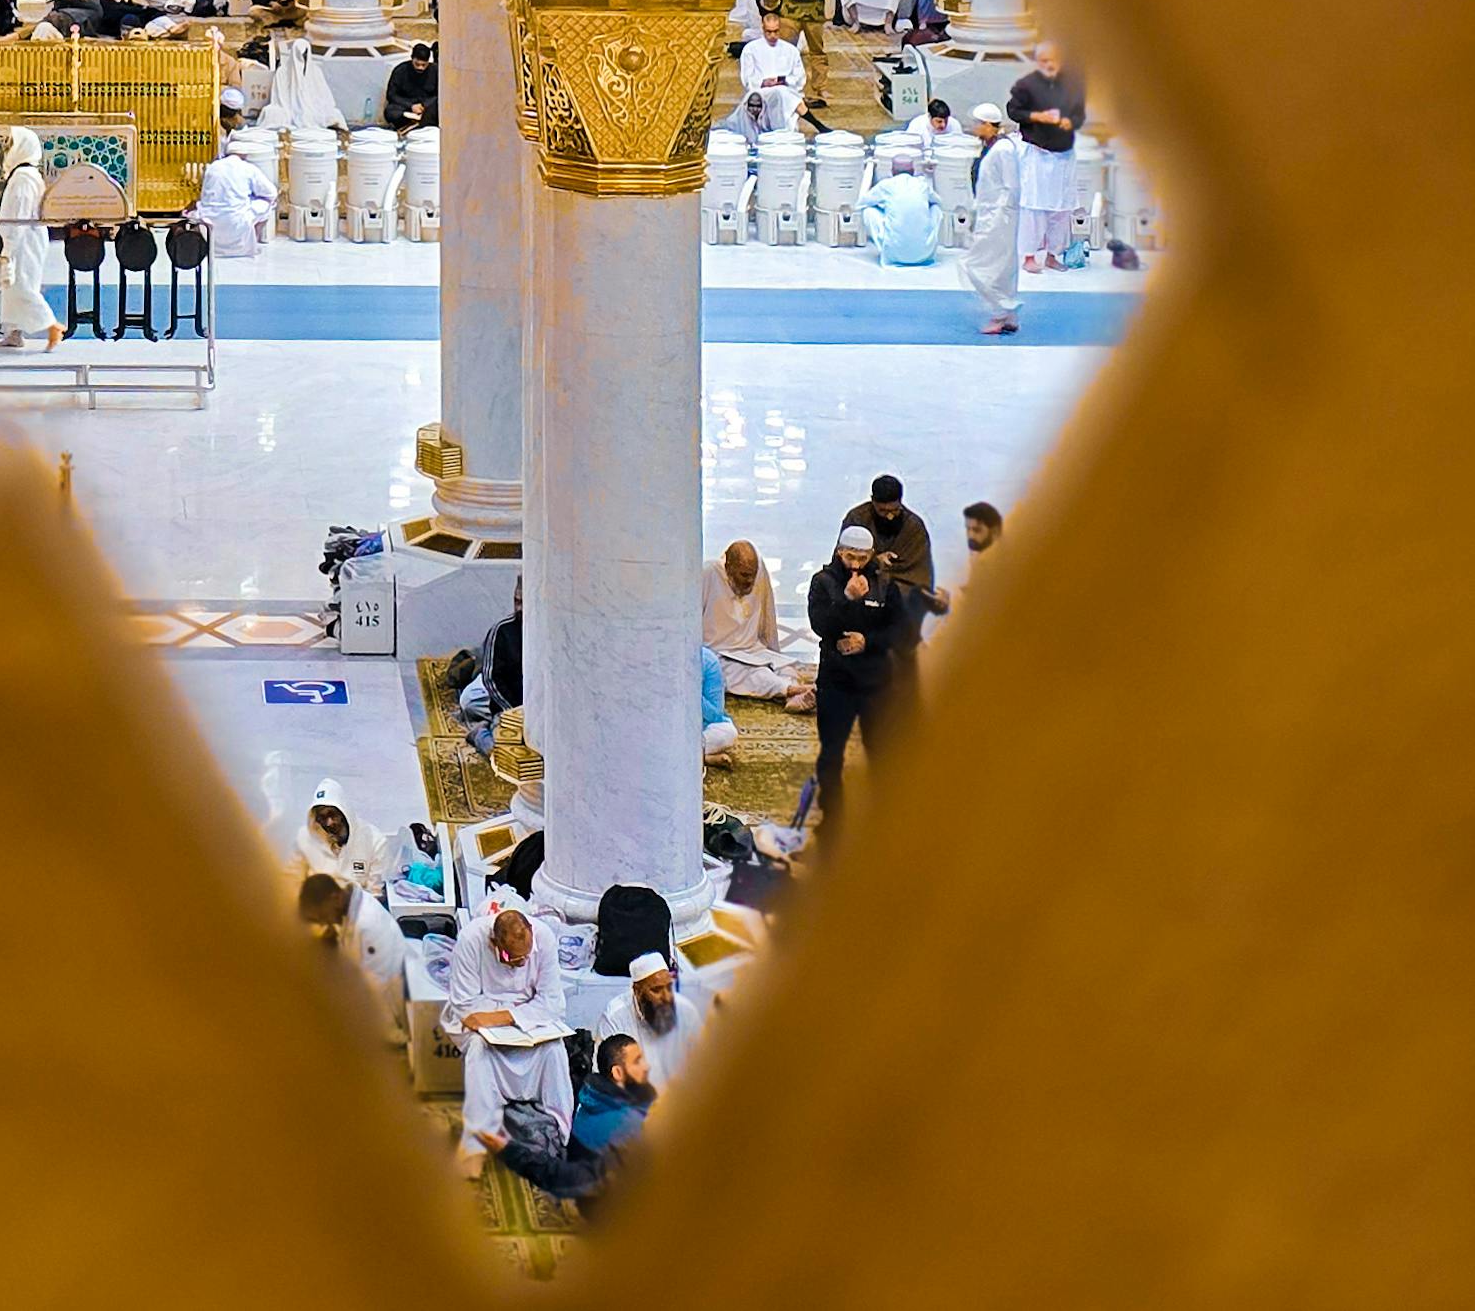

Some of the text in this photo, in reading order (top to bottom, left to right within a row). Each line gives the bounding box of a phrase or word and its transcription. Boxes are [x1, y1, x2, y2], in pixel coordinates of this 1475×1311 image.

[355, 601, 380, 613] ٤١٥
[355, 615, 380, 627] 415
[433, 1043, 462, 1058] 416
